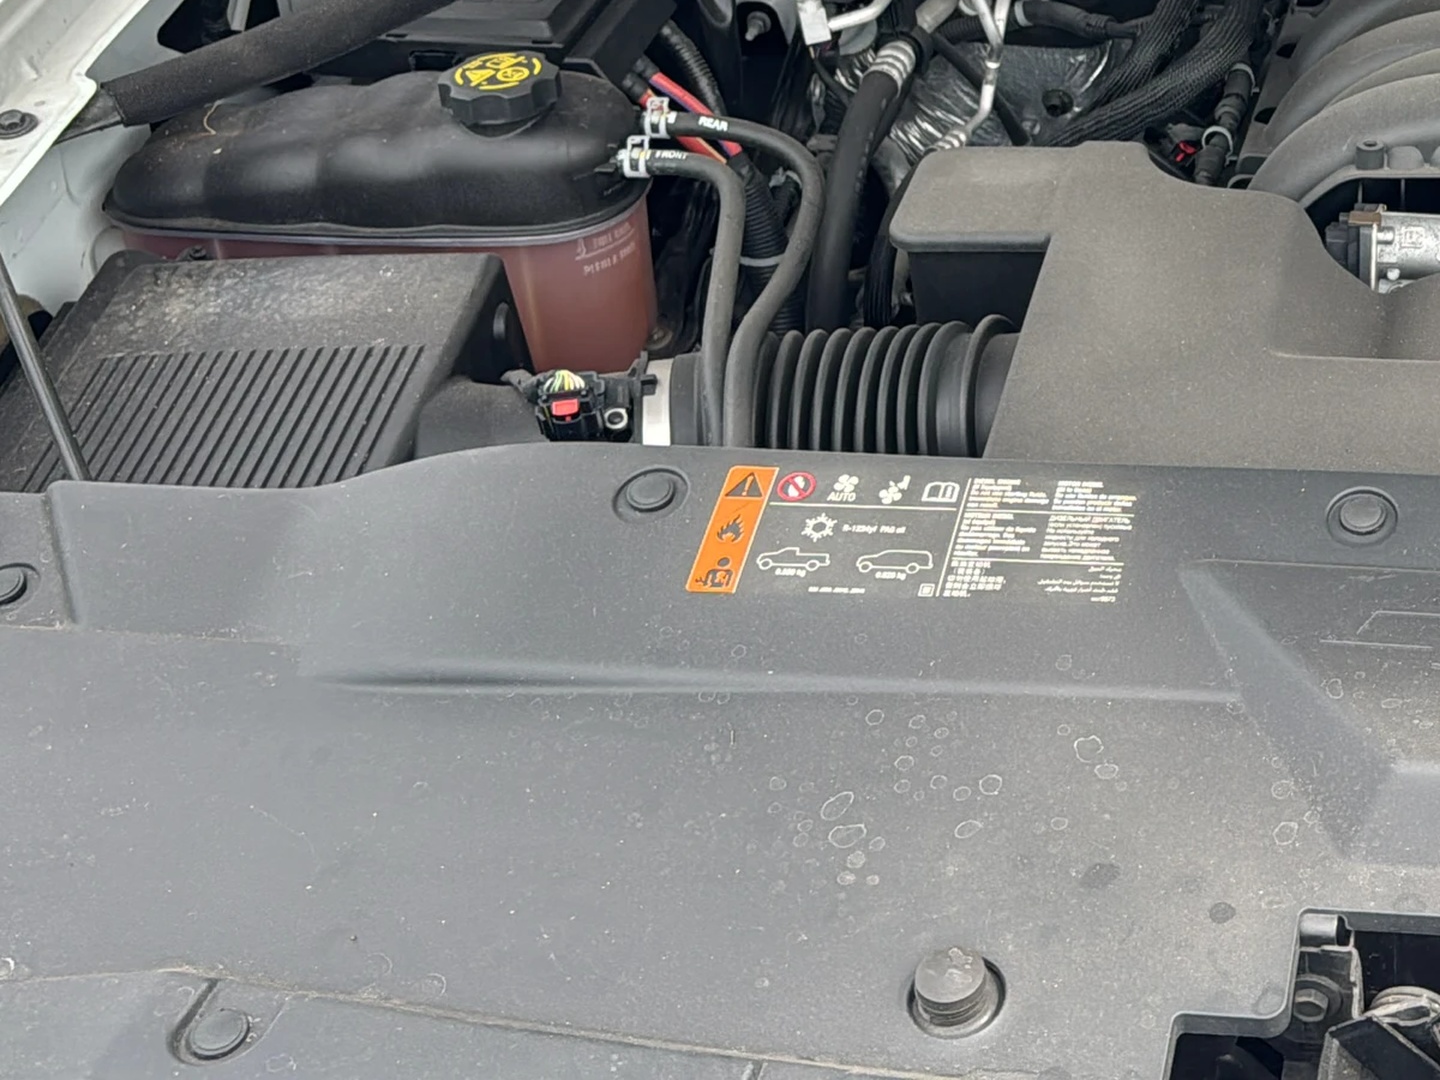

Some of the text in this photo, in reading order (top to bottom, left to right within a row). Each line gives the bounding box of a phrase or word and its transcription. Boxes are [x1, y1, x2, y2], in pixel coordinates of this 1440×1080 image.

[698, 116, 728, 132] REAR
[655, 150, 688, 160] FRONT
[827, 492, 856, 502] AUTO
